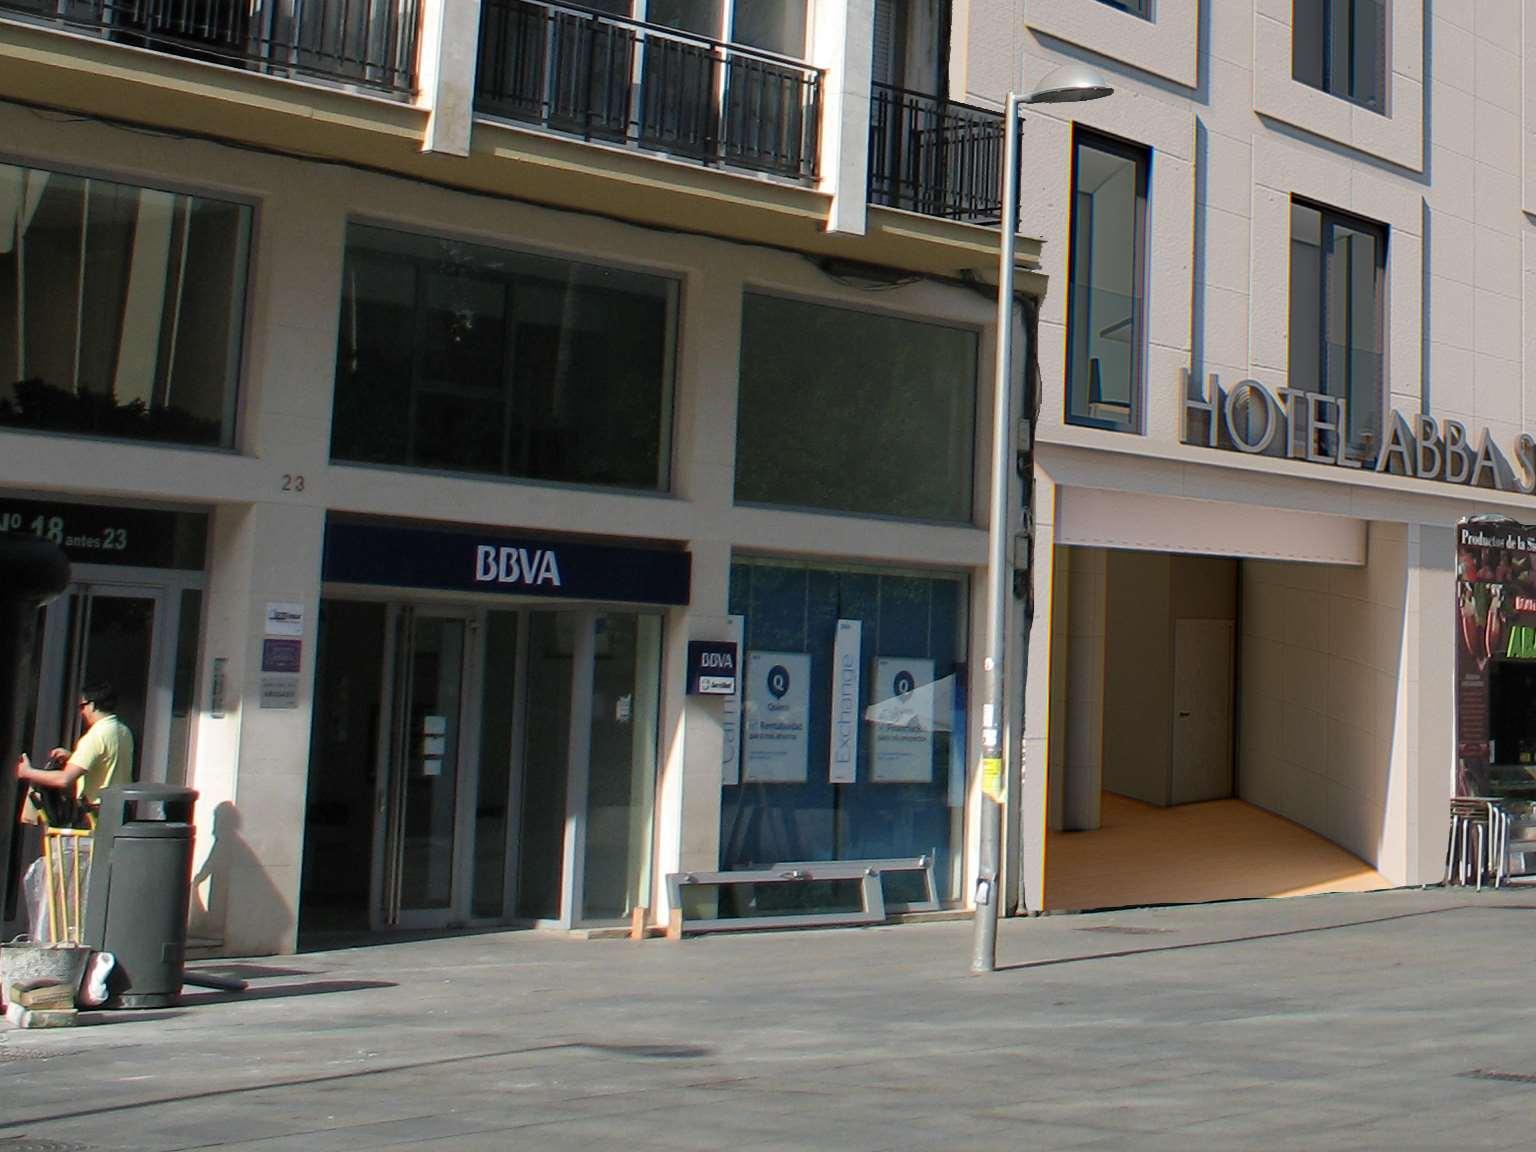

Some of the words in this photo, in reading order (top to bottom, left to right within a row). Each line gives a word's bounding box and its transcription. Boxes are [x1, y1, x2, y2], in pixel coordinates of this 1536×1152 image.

[1178, 367, 1362, 469] HOTEL
[1376, 409, 1500, 489] ABBA
[281, 474, 305, 492] 23
[65, 535, 101, 548] antes
[102, 528, 128, 549] 23
[1517, 536, 1526, 550] la
[475, 545, 561, 586] BBVA
[701, 652, 733, 668] BBVA
[835, 653, 855, 763] Exchange
